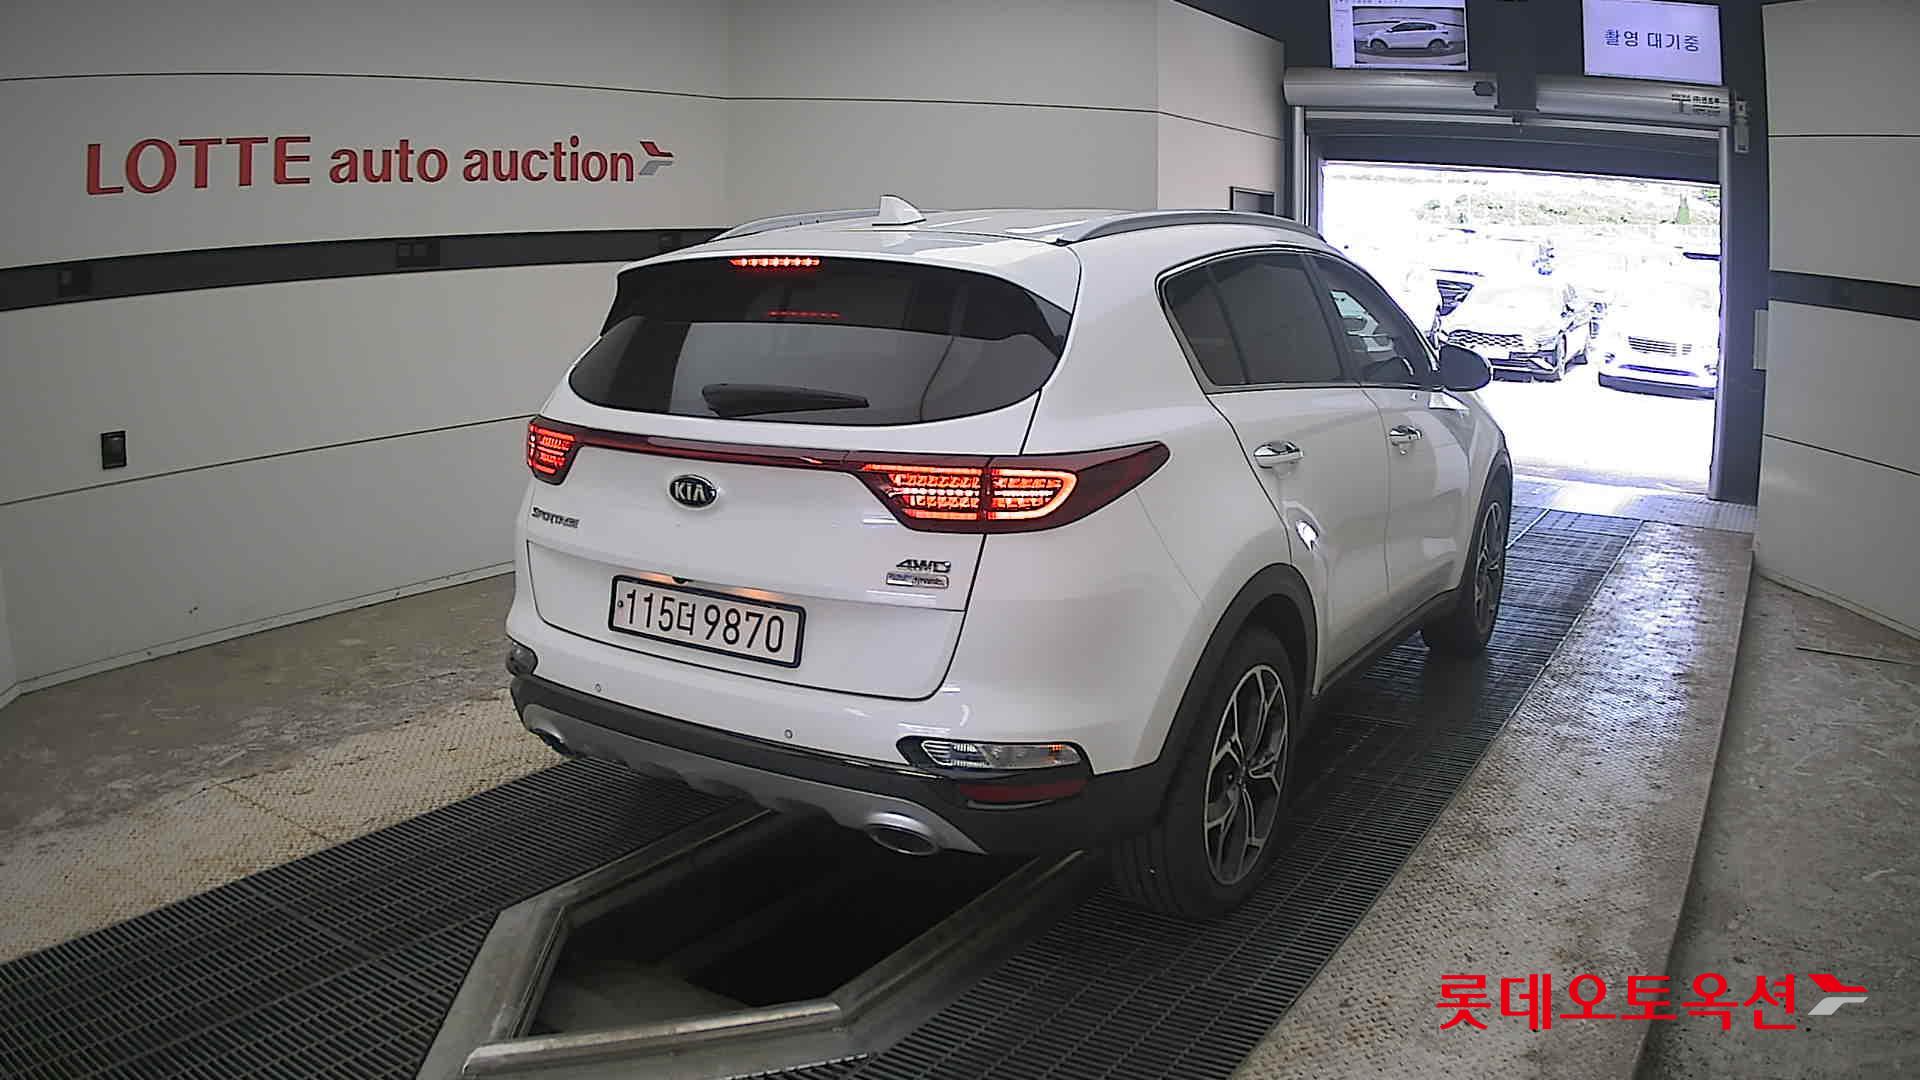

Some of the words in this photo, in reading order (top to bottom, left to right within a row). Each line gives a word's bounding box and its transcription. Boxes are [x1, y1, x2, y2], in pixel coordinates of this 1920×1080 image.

[1647, 32, 1699, 52] 대기중
[87, 136, 311, 195] LOTTE
[329, 140, 448, 183] auto
[463, 135, 634, 182] auction
[674, 481, 706, 501] KIA
[704, 604, 785, 653] 9870
